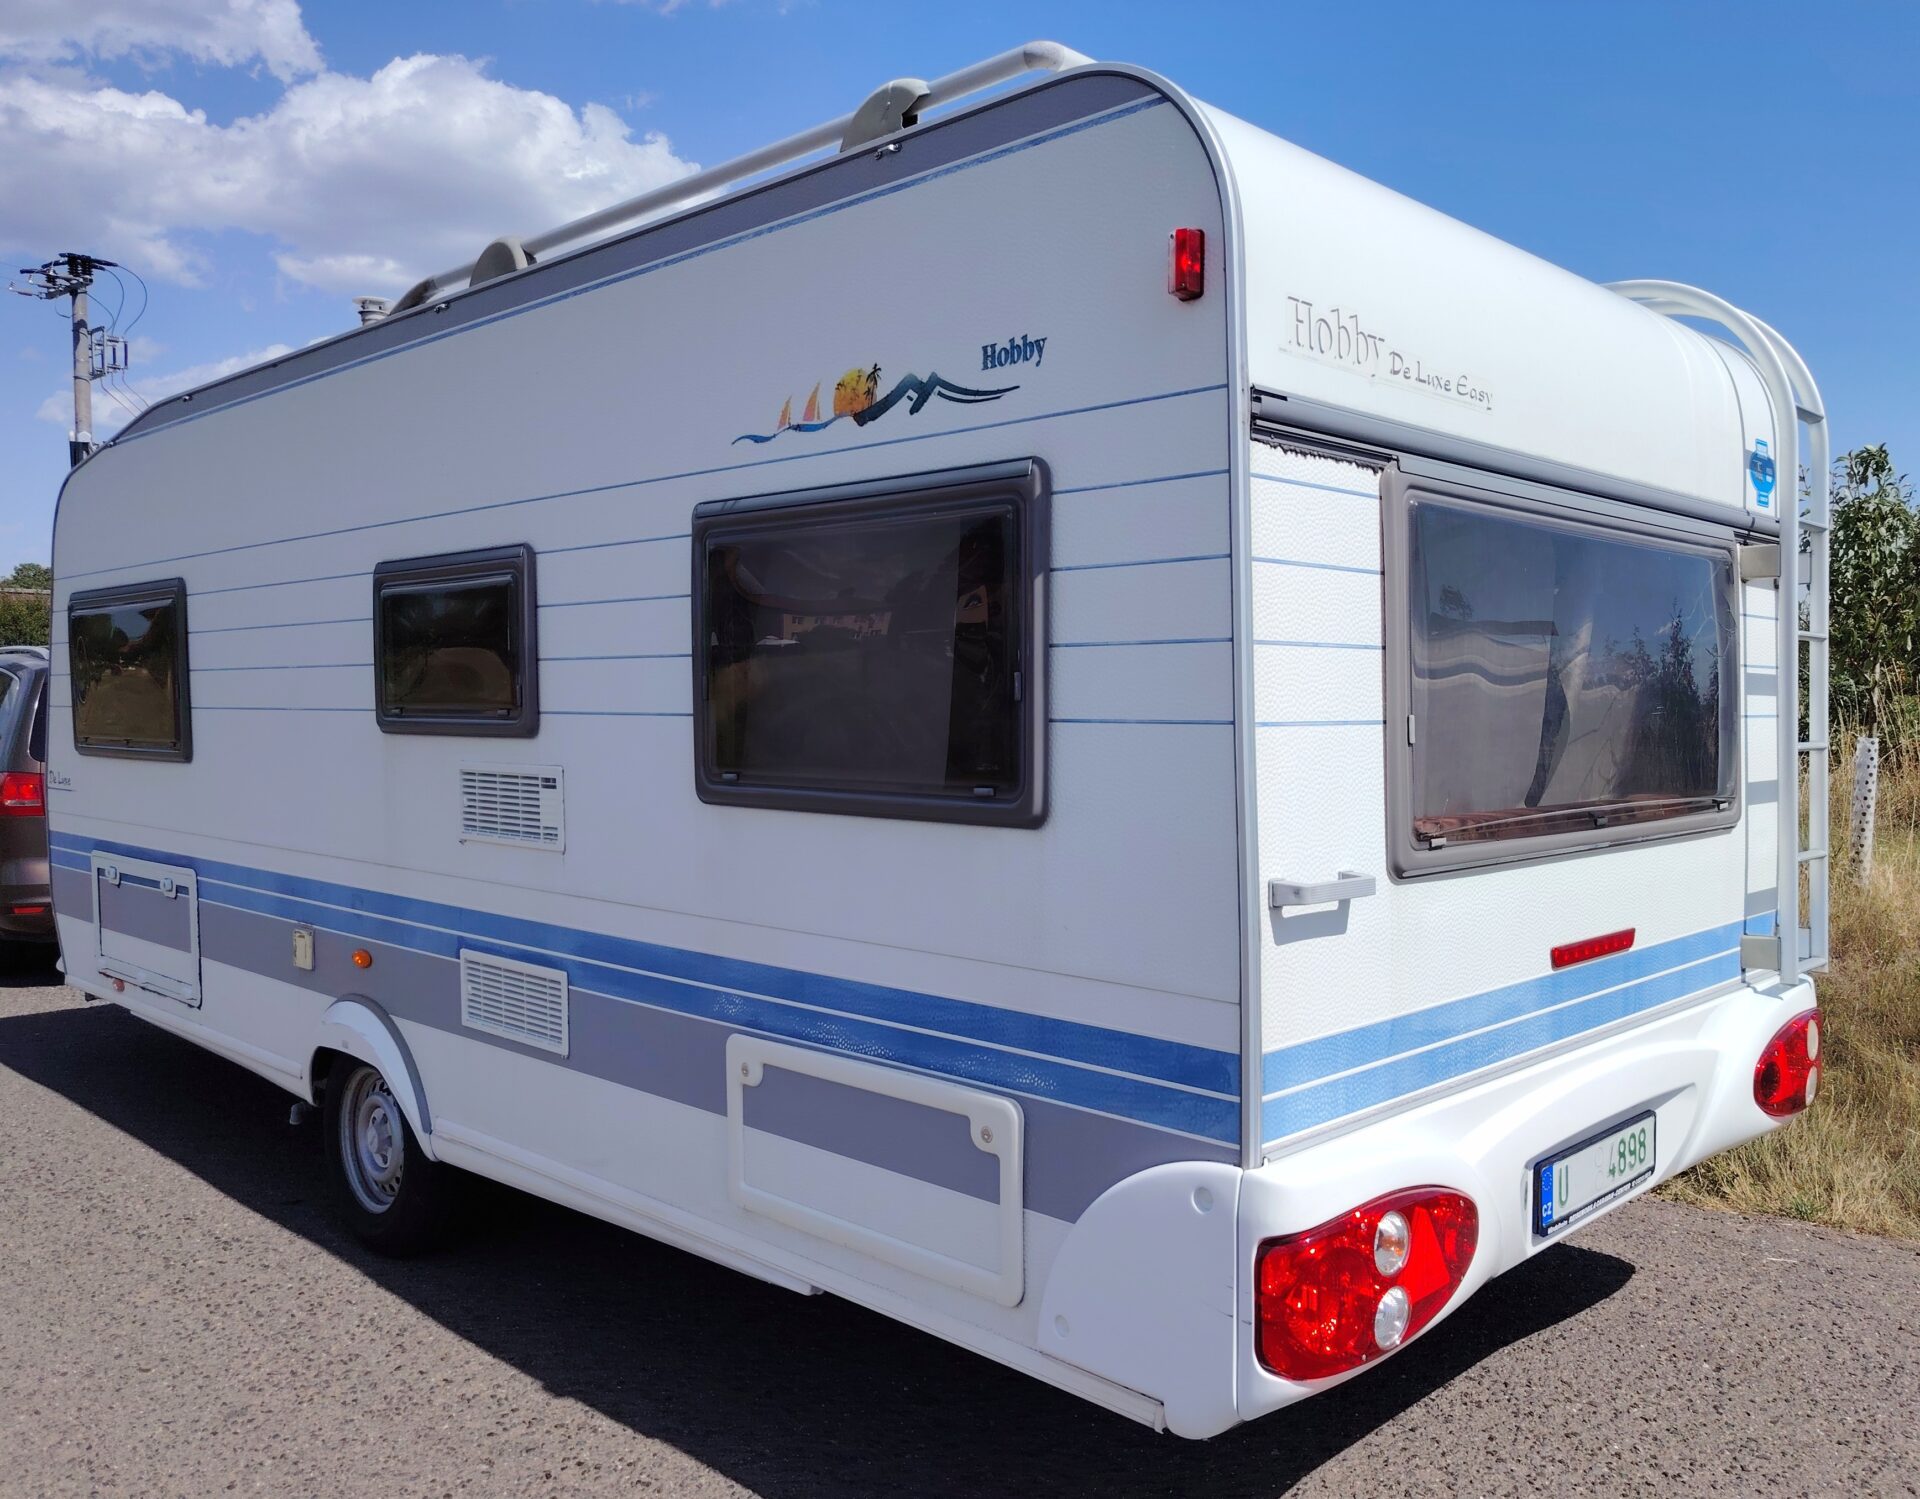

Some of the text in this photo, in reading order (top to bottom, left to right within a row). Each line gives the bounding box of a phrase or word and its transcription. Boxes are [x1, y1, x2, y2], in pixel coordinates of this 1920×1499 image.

[981, 333, 1047, 370] Hobby
[1286, 295, 1494, 411] Hobby De Luxe Easy
[1542, 1202, 1553, 1217] CZ
